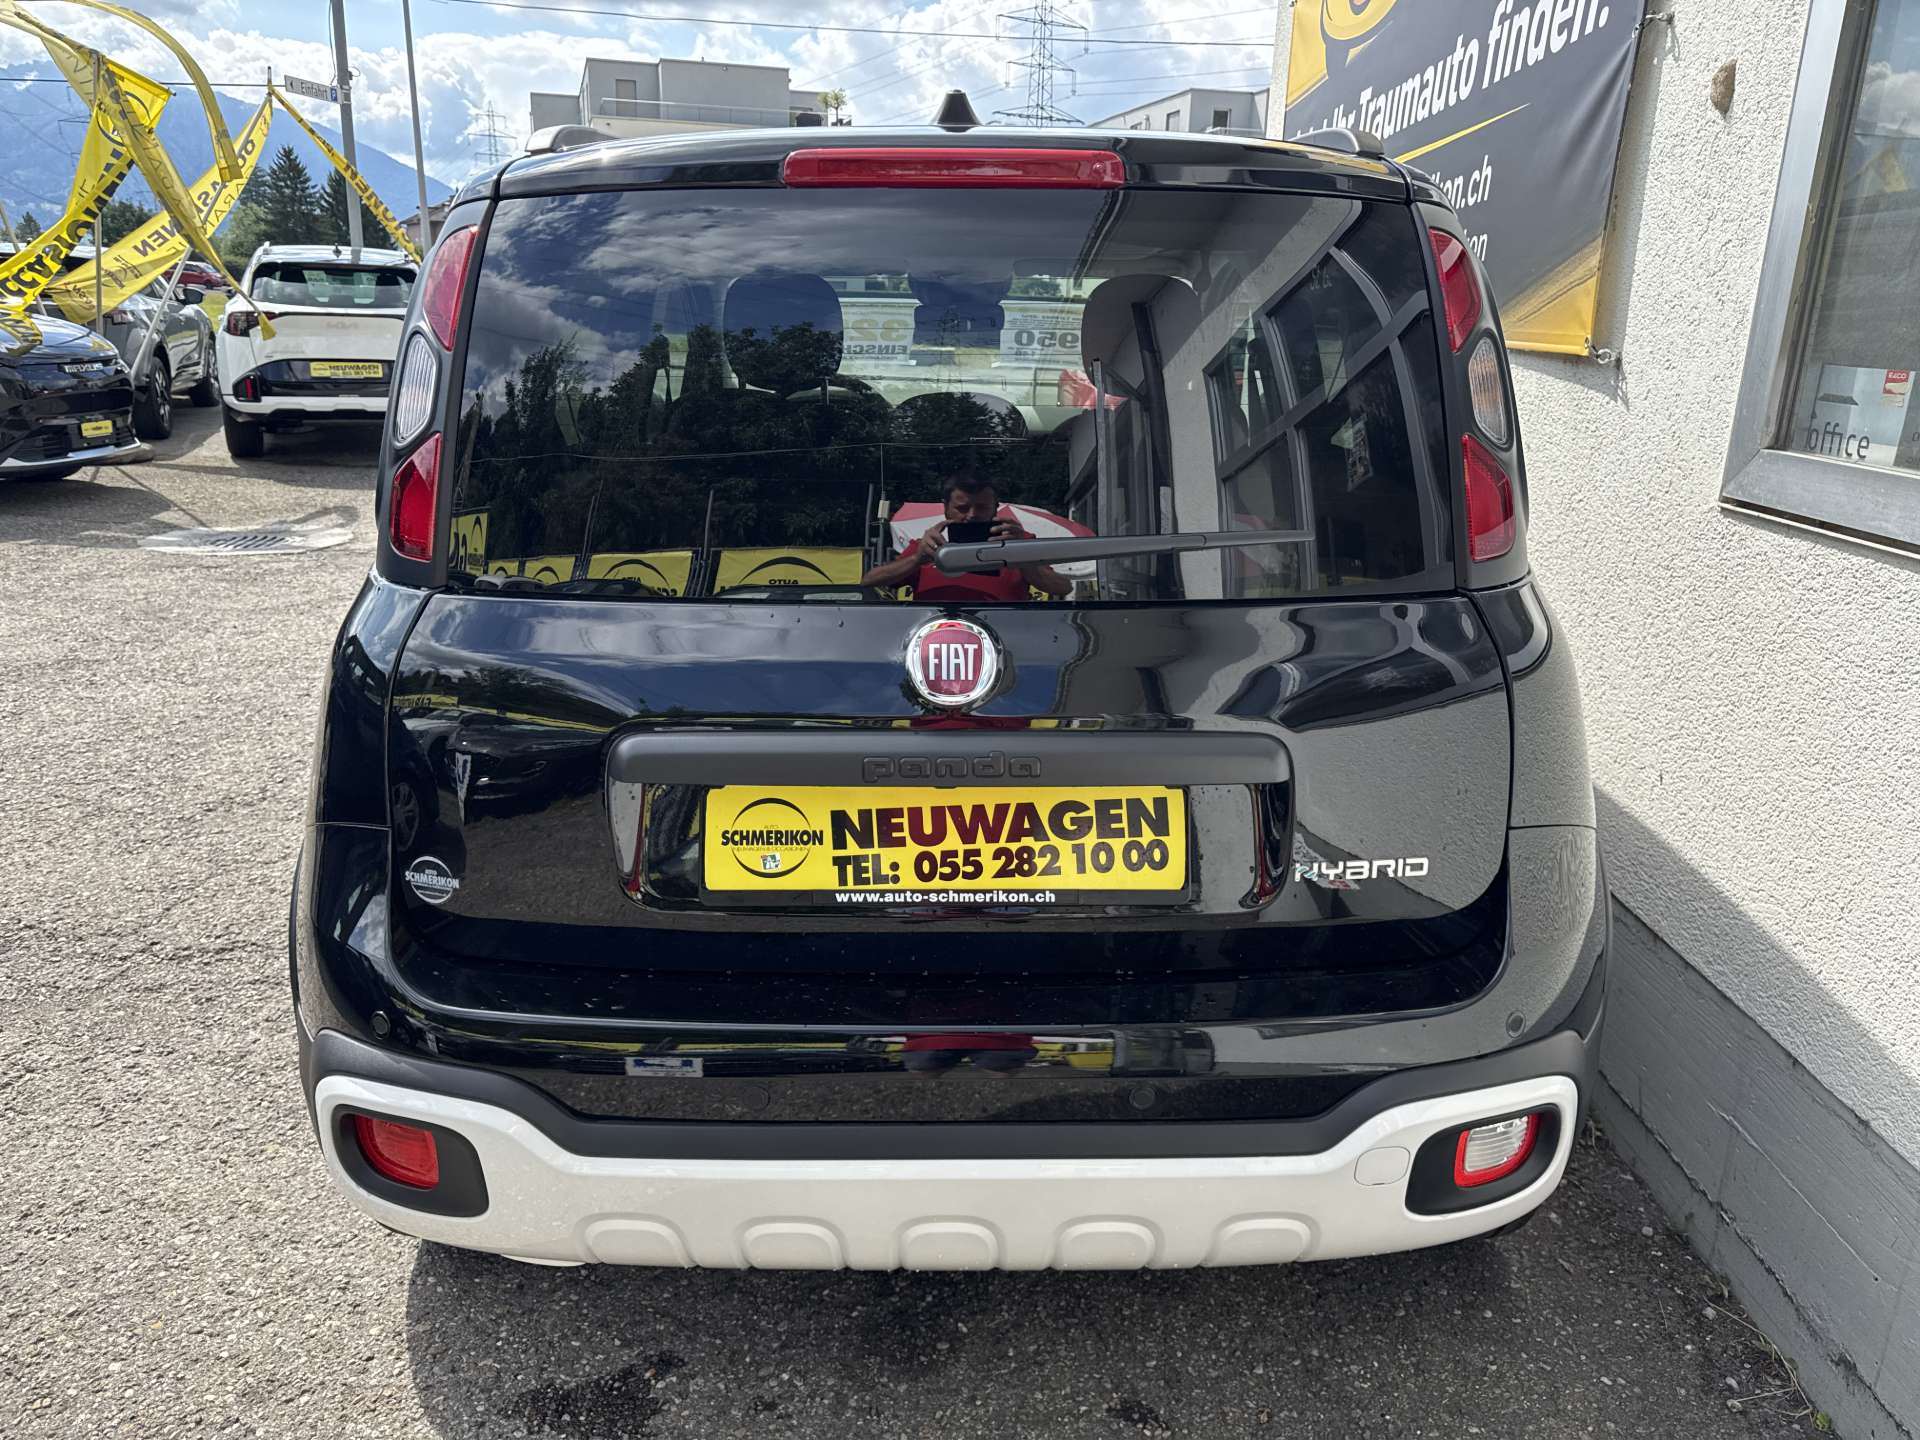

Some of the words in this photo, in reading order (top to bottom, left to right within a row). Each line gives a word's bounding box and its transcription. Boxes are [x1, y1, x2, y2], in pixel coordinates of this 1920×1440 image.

[301, 81, 329, 100] Einfahrt
[1359, 33, 1478, 141] Traumauto
[1808, 422, 1870, 459] office
[928, 643, 978, 681] FIAT
[862, 750, 1042, 783] panda
[721, 830, 824, 846] SCHMERIKON
[830, 797, 1170, 850] NEUWAGEN
[832, 853, 901, 887] TEL:
[914, 848, 984, 883] 055
[991, 844, 1062, 879] 282
[1071, 842, 1115, 875] 10
[1122, 838, 1169, 872] 00
[1294, 857, 1429, 882] HYBRID
[405, 870, 460, 889] SCHMERIKON
[834, 890, 1056, 903] www.auto-schmerikon.ch
